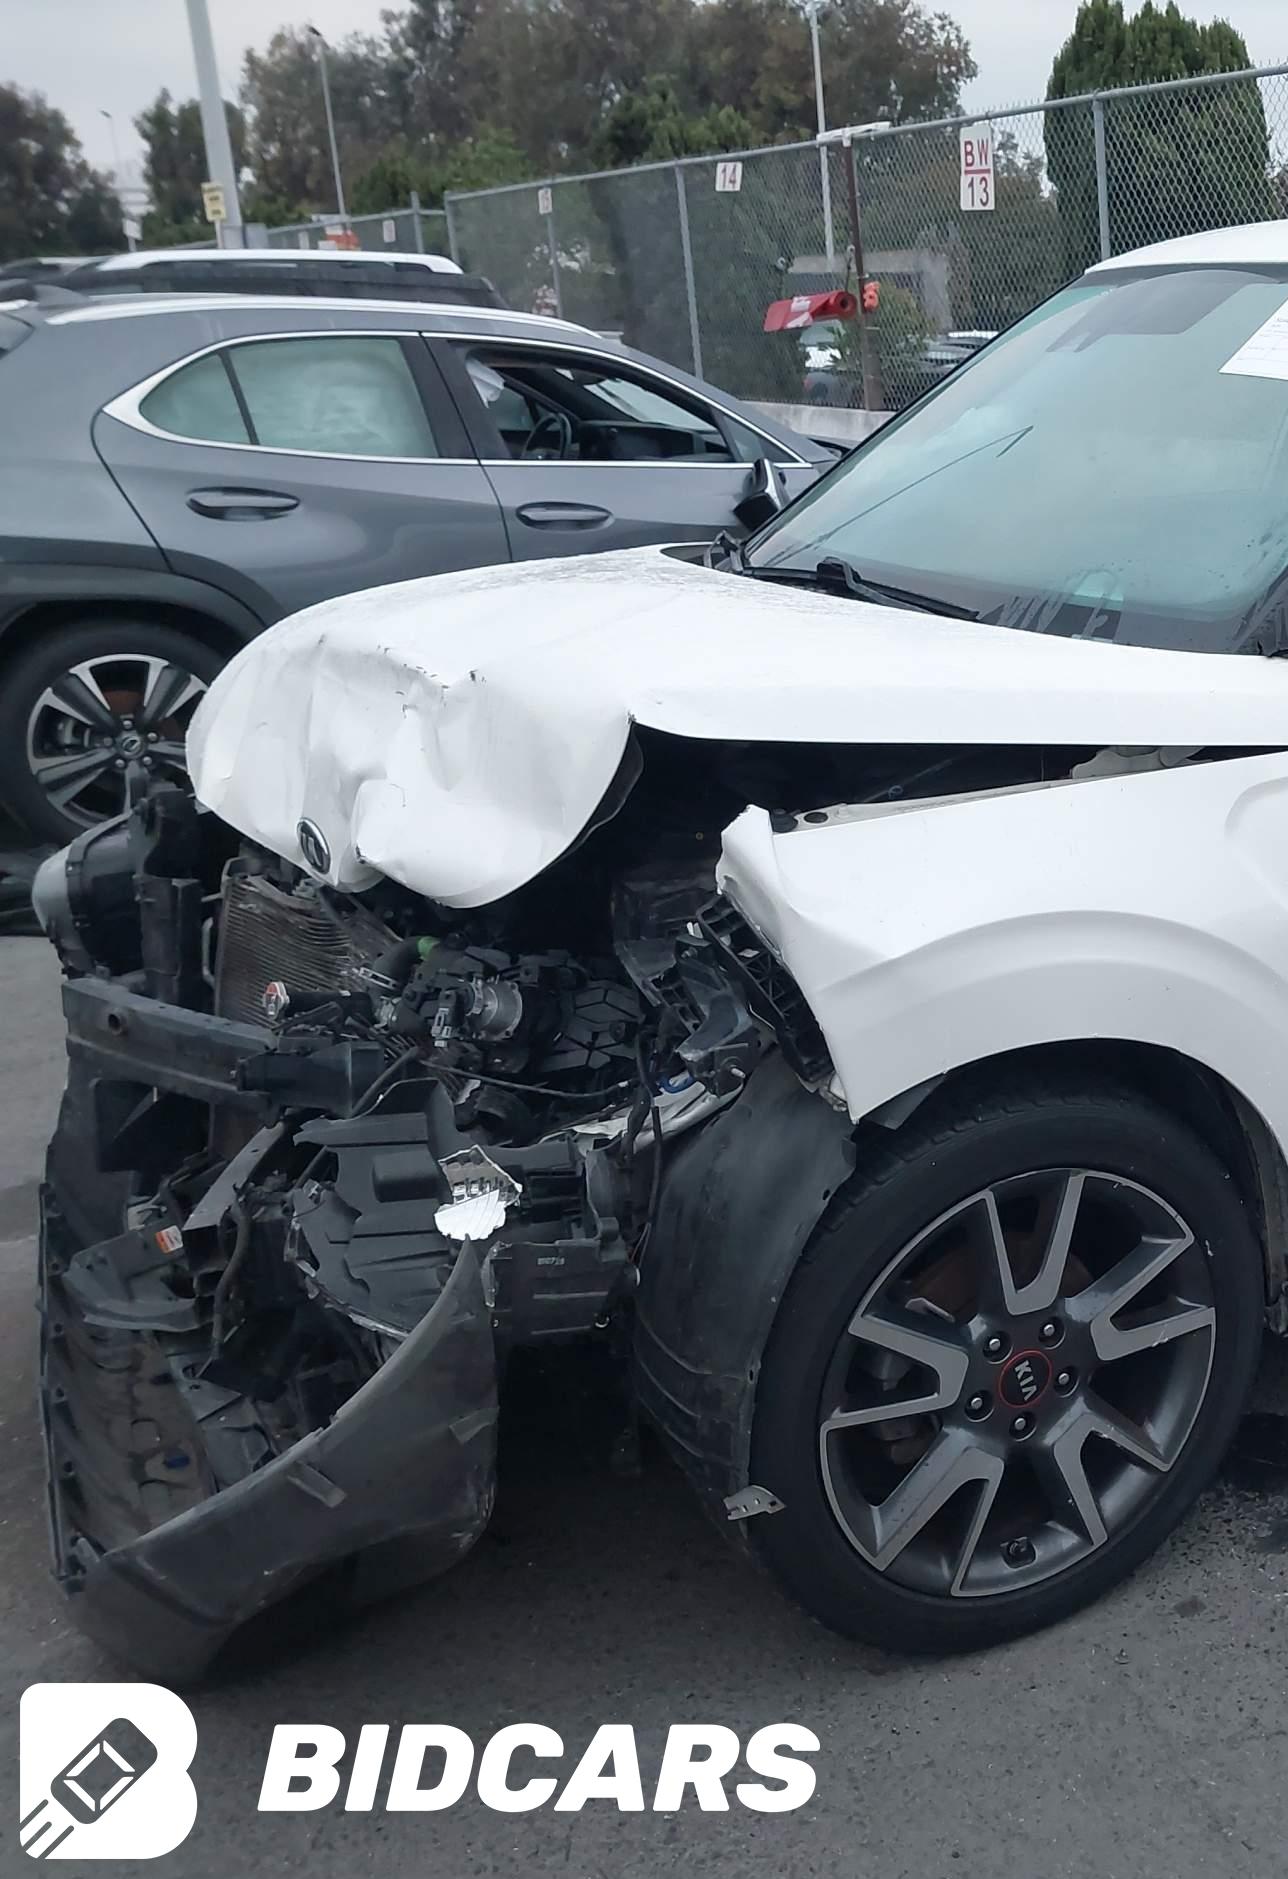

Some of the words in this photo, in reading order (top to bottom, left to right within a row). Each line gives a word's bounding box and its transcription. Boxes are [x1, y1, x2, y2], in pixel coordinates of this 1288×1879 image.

[964, 139, 991, 168] BW
[720, 163, 738, 190] 14
[967, 176, 990, 207] 13
[1014, 1360, 1037, 1401] KIA
